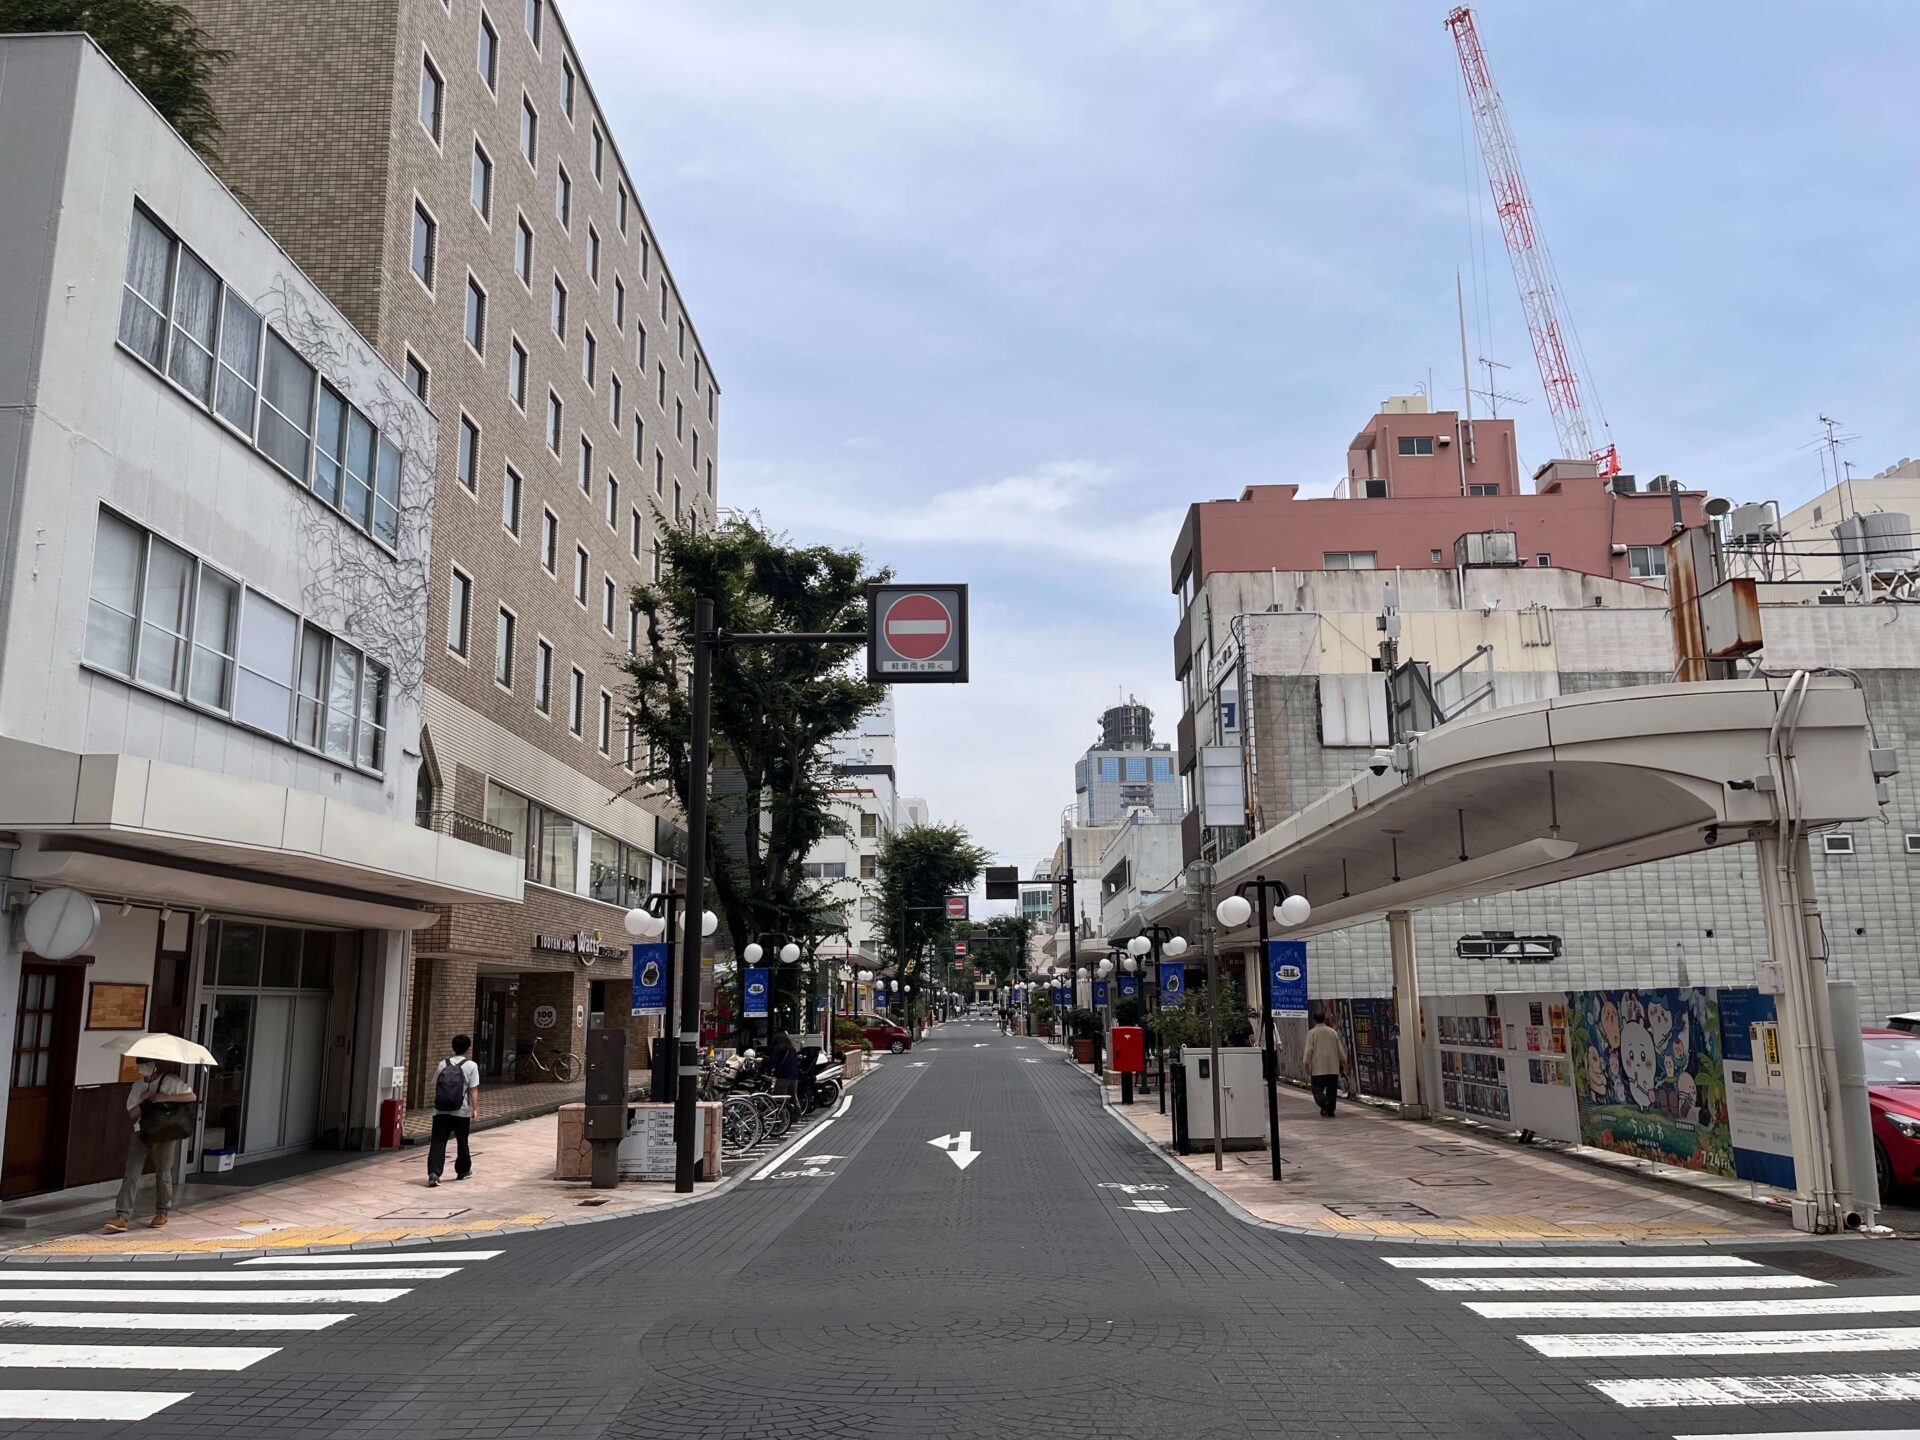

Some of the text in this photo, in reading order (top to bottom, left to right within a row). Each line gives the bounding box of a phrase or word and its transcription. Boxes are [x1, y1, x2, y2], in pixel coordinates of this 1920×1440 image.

[891, 662, 944, 671] 軽車両を除く
[540, 935, 561, 950] 100YEN
[561, 939, 576, 953] SHOP
[577, 929, 600, 955] Watts
[1630, 1118, 1664, 1140] ちいかわ
